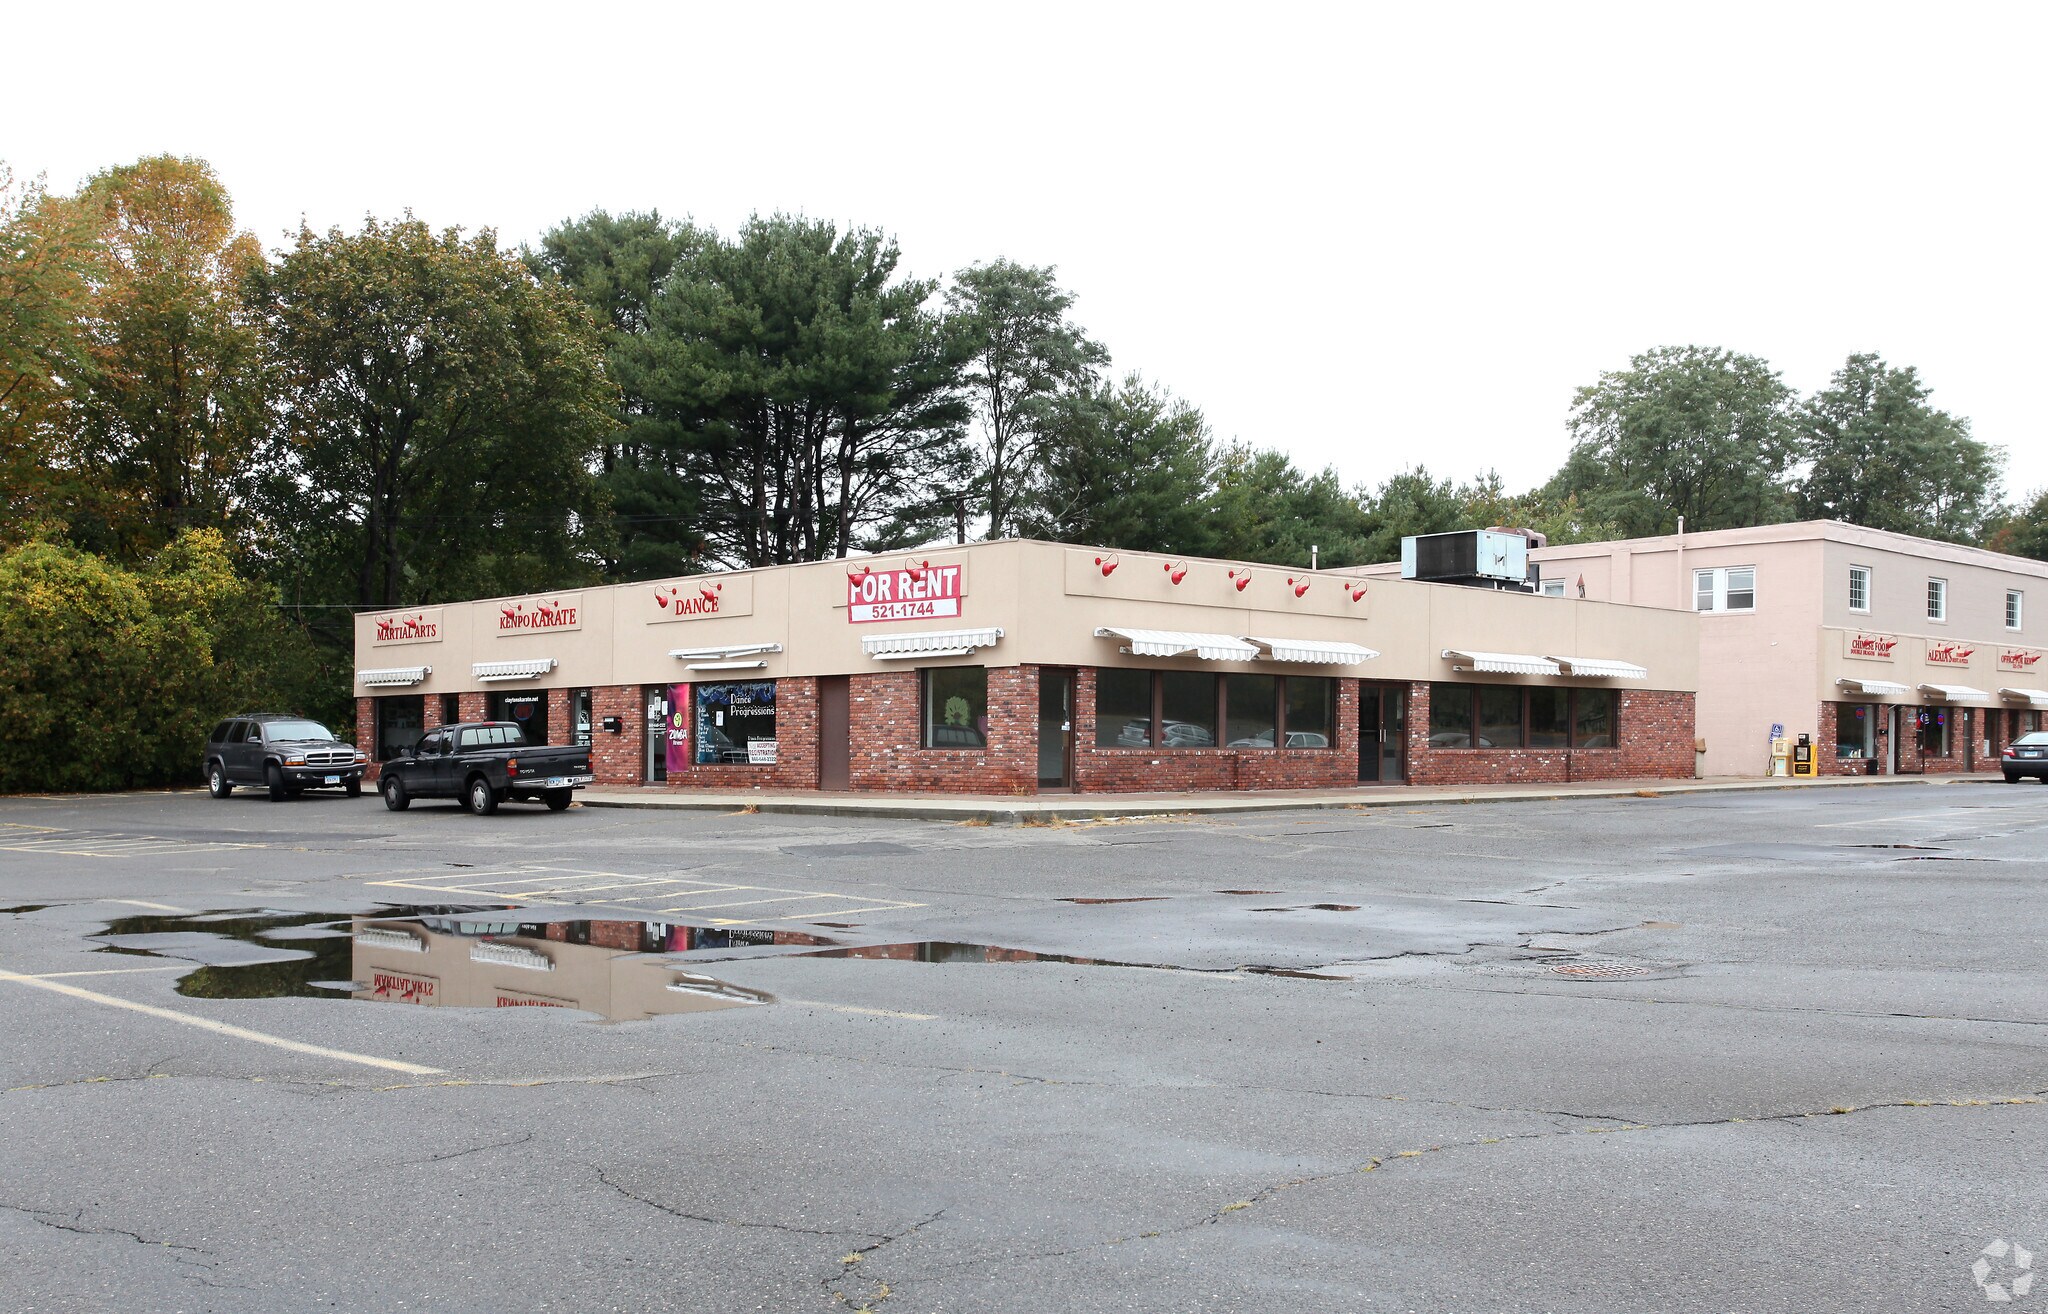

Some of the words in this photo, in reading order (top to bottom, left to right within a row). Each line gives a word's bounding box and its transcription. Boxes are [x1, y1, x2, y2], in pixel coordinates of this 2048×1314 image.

[850, 574, 892, 603] FOR
[898, 568, 957, 599] RENT
[675, 596, 719, 615] DANCE
[872, 602, 934, 618] 521-1744
[500, 614, 530, 629] KENPO
[531, 608, 577, 628] KARATE
[376, 626, 412, 641] MARTIAL
[414, 624, 437, 638] ARTS
[1852, 639, 1875, 651] CHISE
[730, 693, 751, 704] Dance
[730, 705, 775, 718] Progressions
